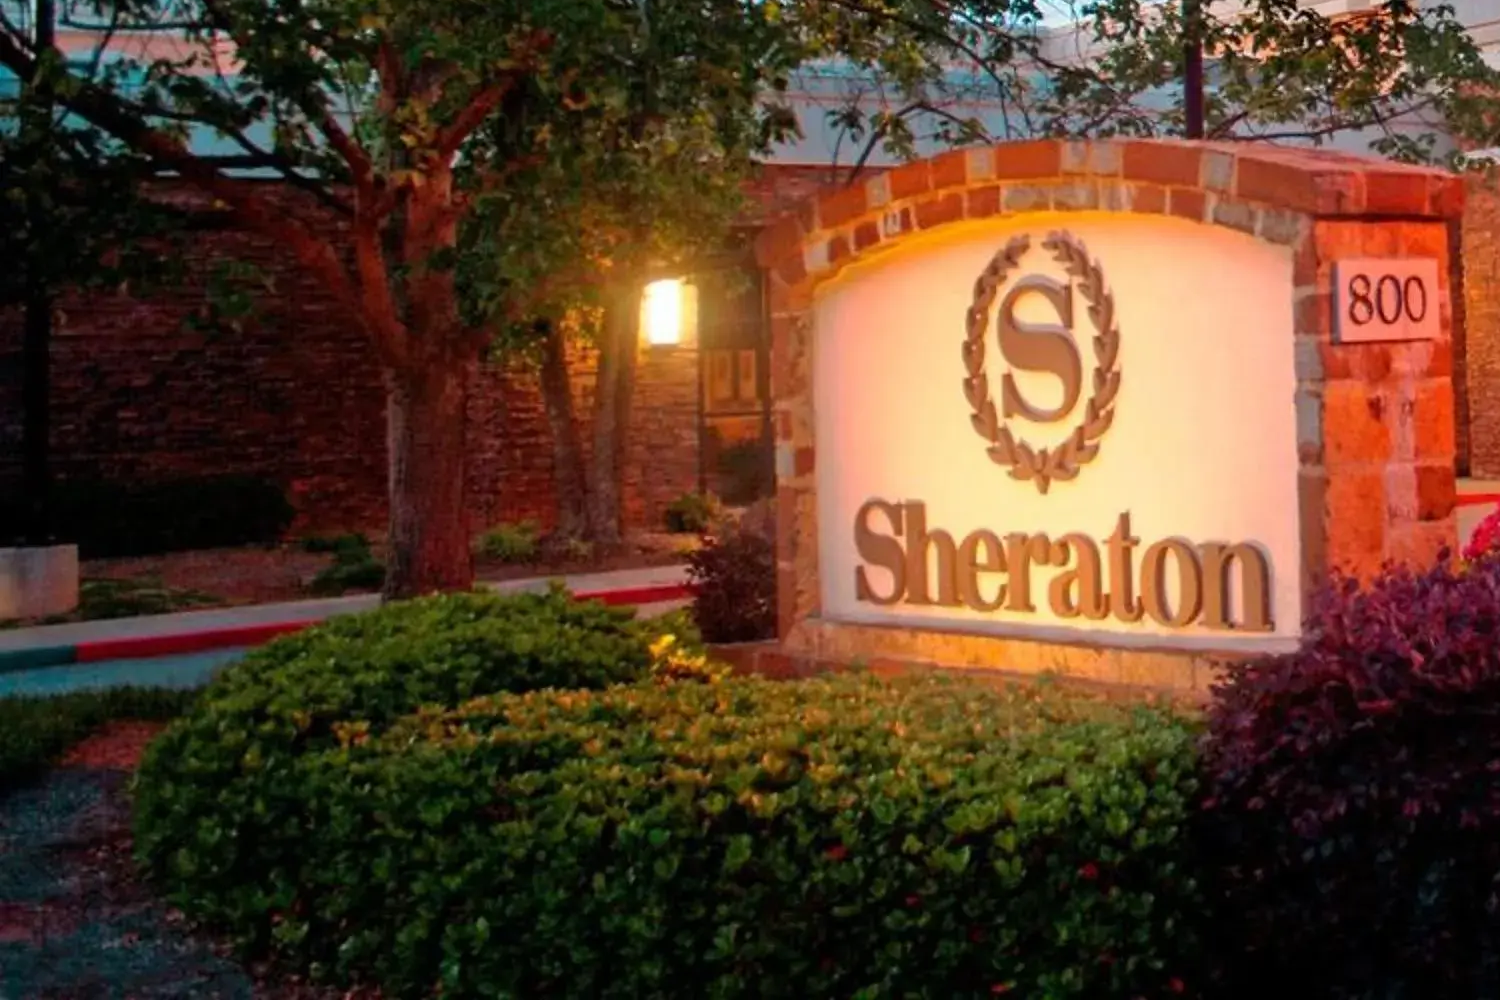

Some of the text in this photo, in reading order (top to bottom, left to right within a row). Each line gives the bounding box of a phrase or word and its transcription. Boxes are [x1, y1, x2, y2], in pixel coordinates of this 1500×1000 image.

[998, 274, 1082, 422] S
[1348, 272, 1427, 326] 800
[853, 497, 1275, 632] Sheraton
